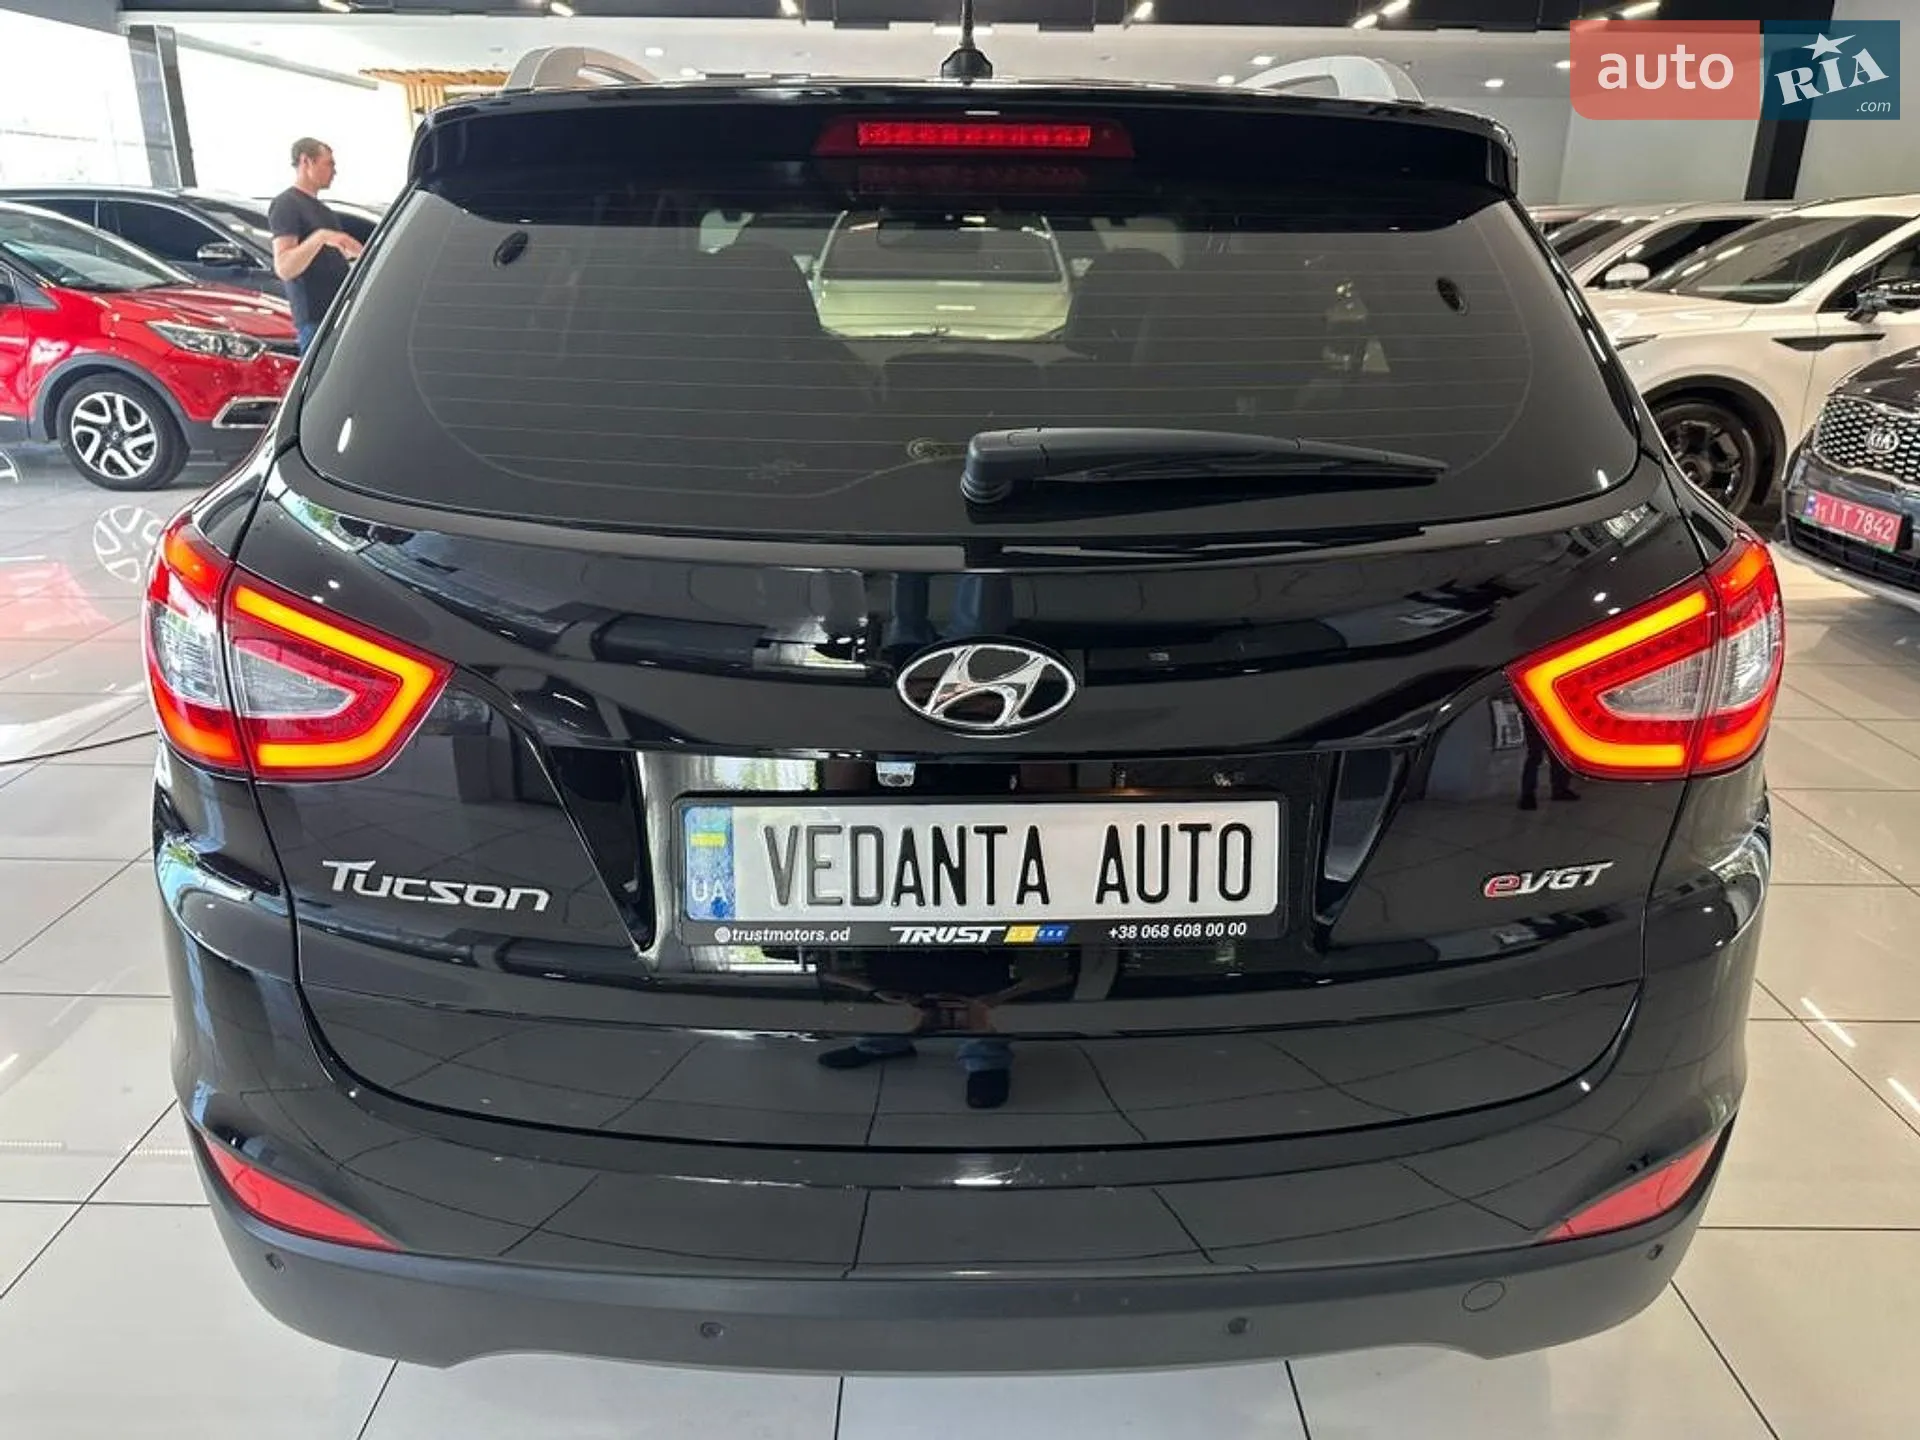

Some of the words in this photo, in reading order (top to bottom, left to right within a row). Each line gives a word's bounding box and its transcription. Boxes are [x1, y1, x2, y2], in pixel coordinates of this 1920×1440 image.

[1854, 508, 1896, 541] 7842
[763, 825, 1050, 907] VEDANTA
[1095, 823, 1253, 905] AUTO
[691, 879, 728, 903] UA
[889, 926, 1008, 944] TRUST
[1108, 924, 1138, 940] +38
[1140, 924, 1170, 939] 068
[1172, 923, 1202, 938] 608
[1205, 922, 1225, 937] 00
[1227, 921, 1247, 936] 00
